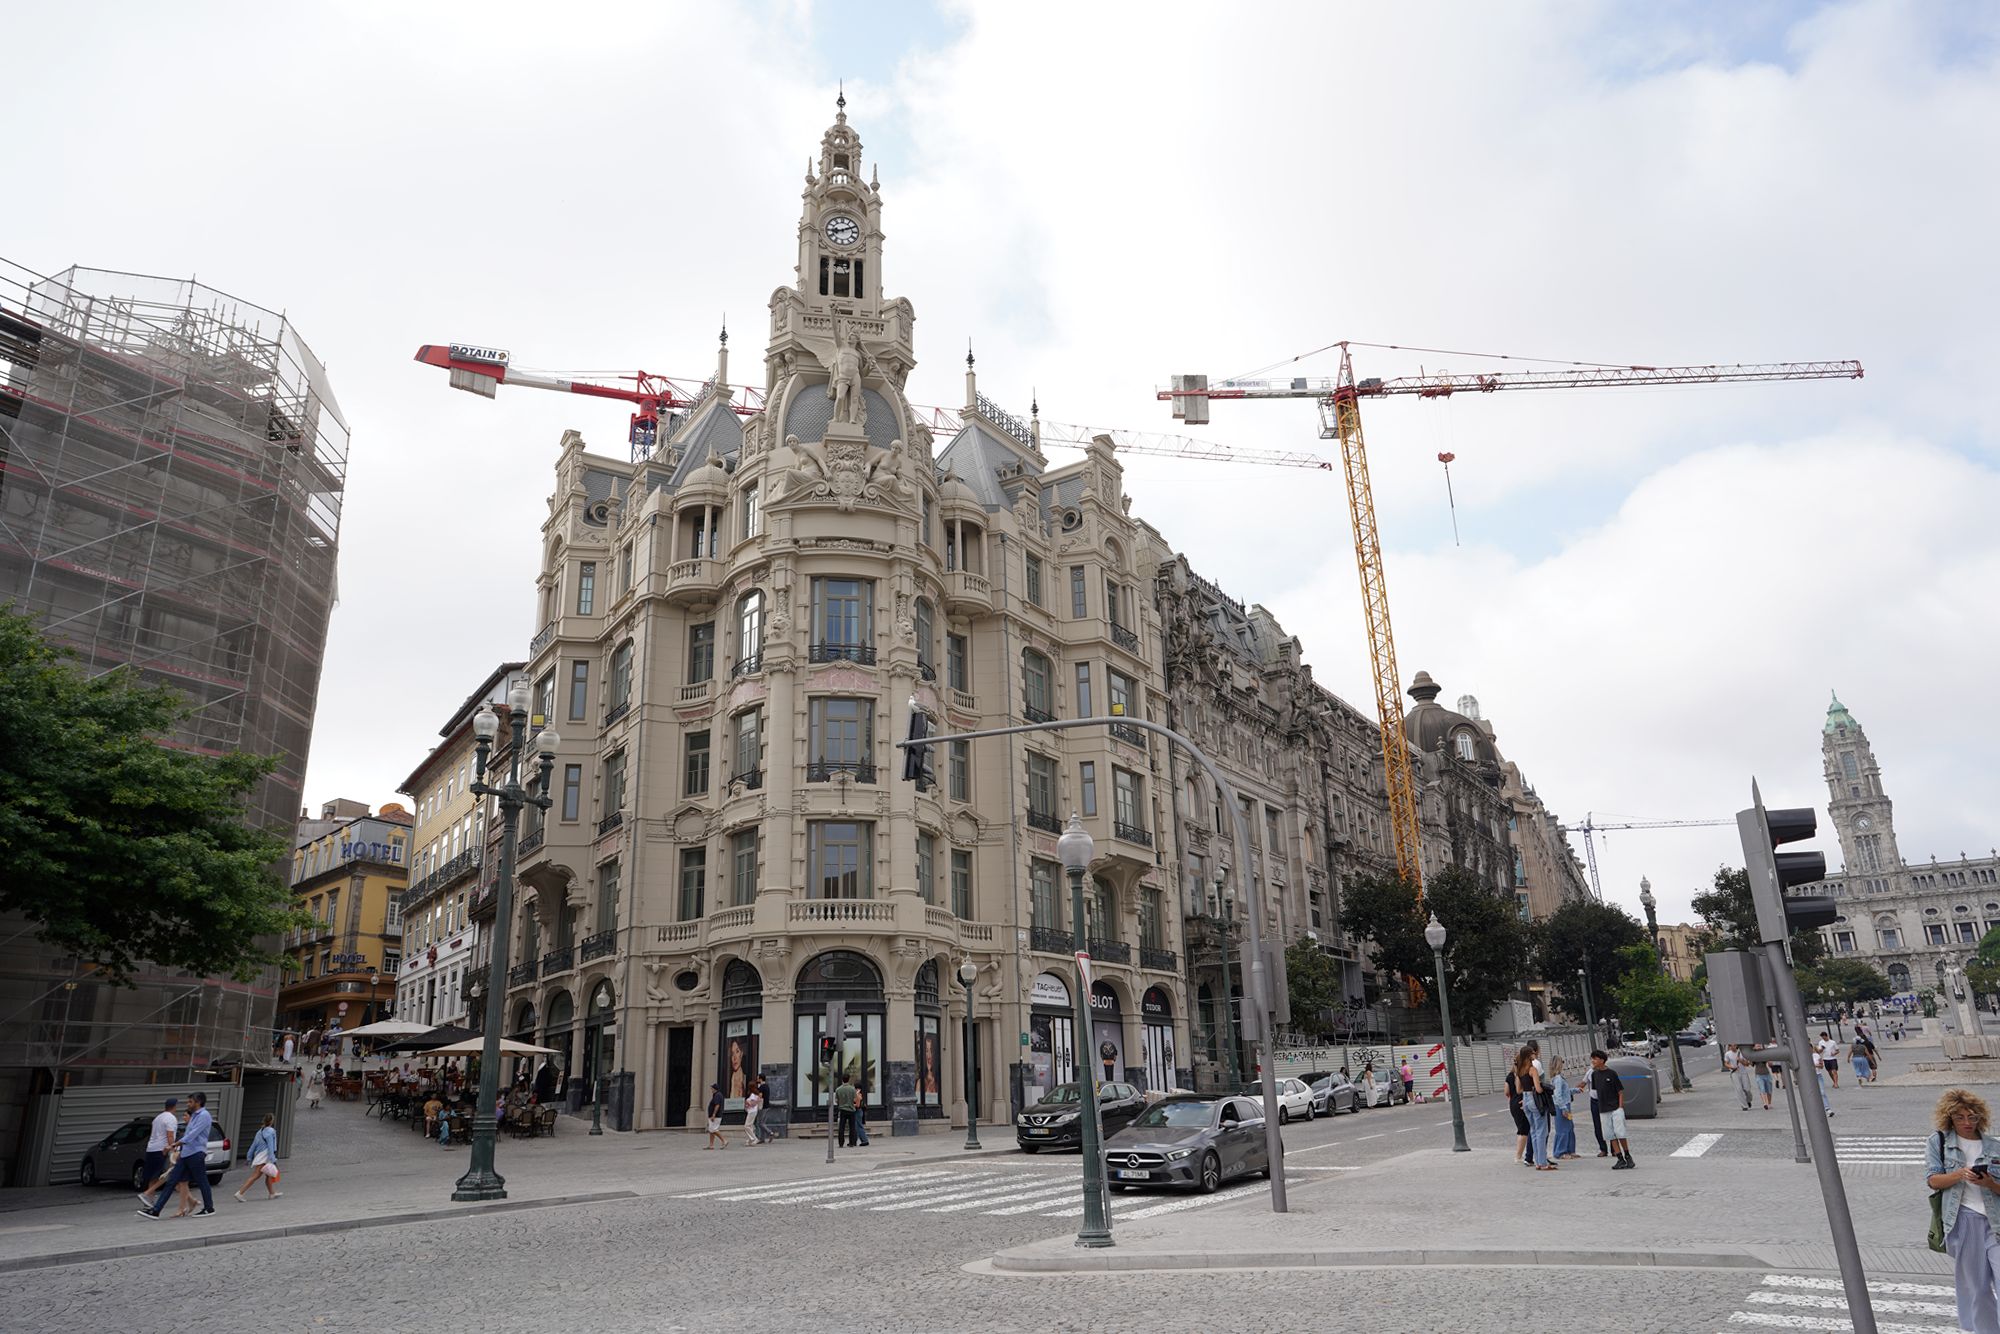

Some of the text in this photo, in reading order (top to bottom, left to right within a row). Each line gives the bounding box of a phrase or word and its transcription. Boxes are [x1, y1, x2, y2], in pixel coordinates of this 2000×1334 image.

[452, 345, 497, 359] POTAIN
[333, 952, 368, 964] HOTEL
[1091, 995, 1114, 1010] BLOT
[1145, 1003, 1162, 1012] TUDOR
